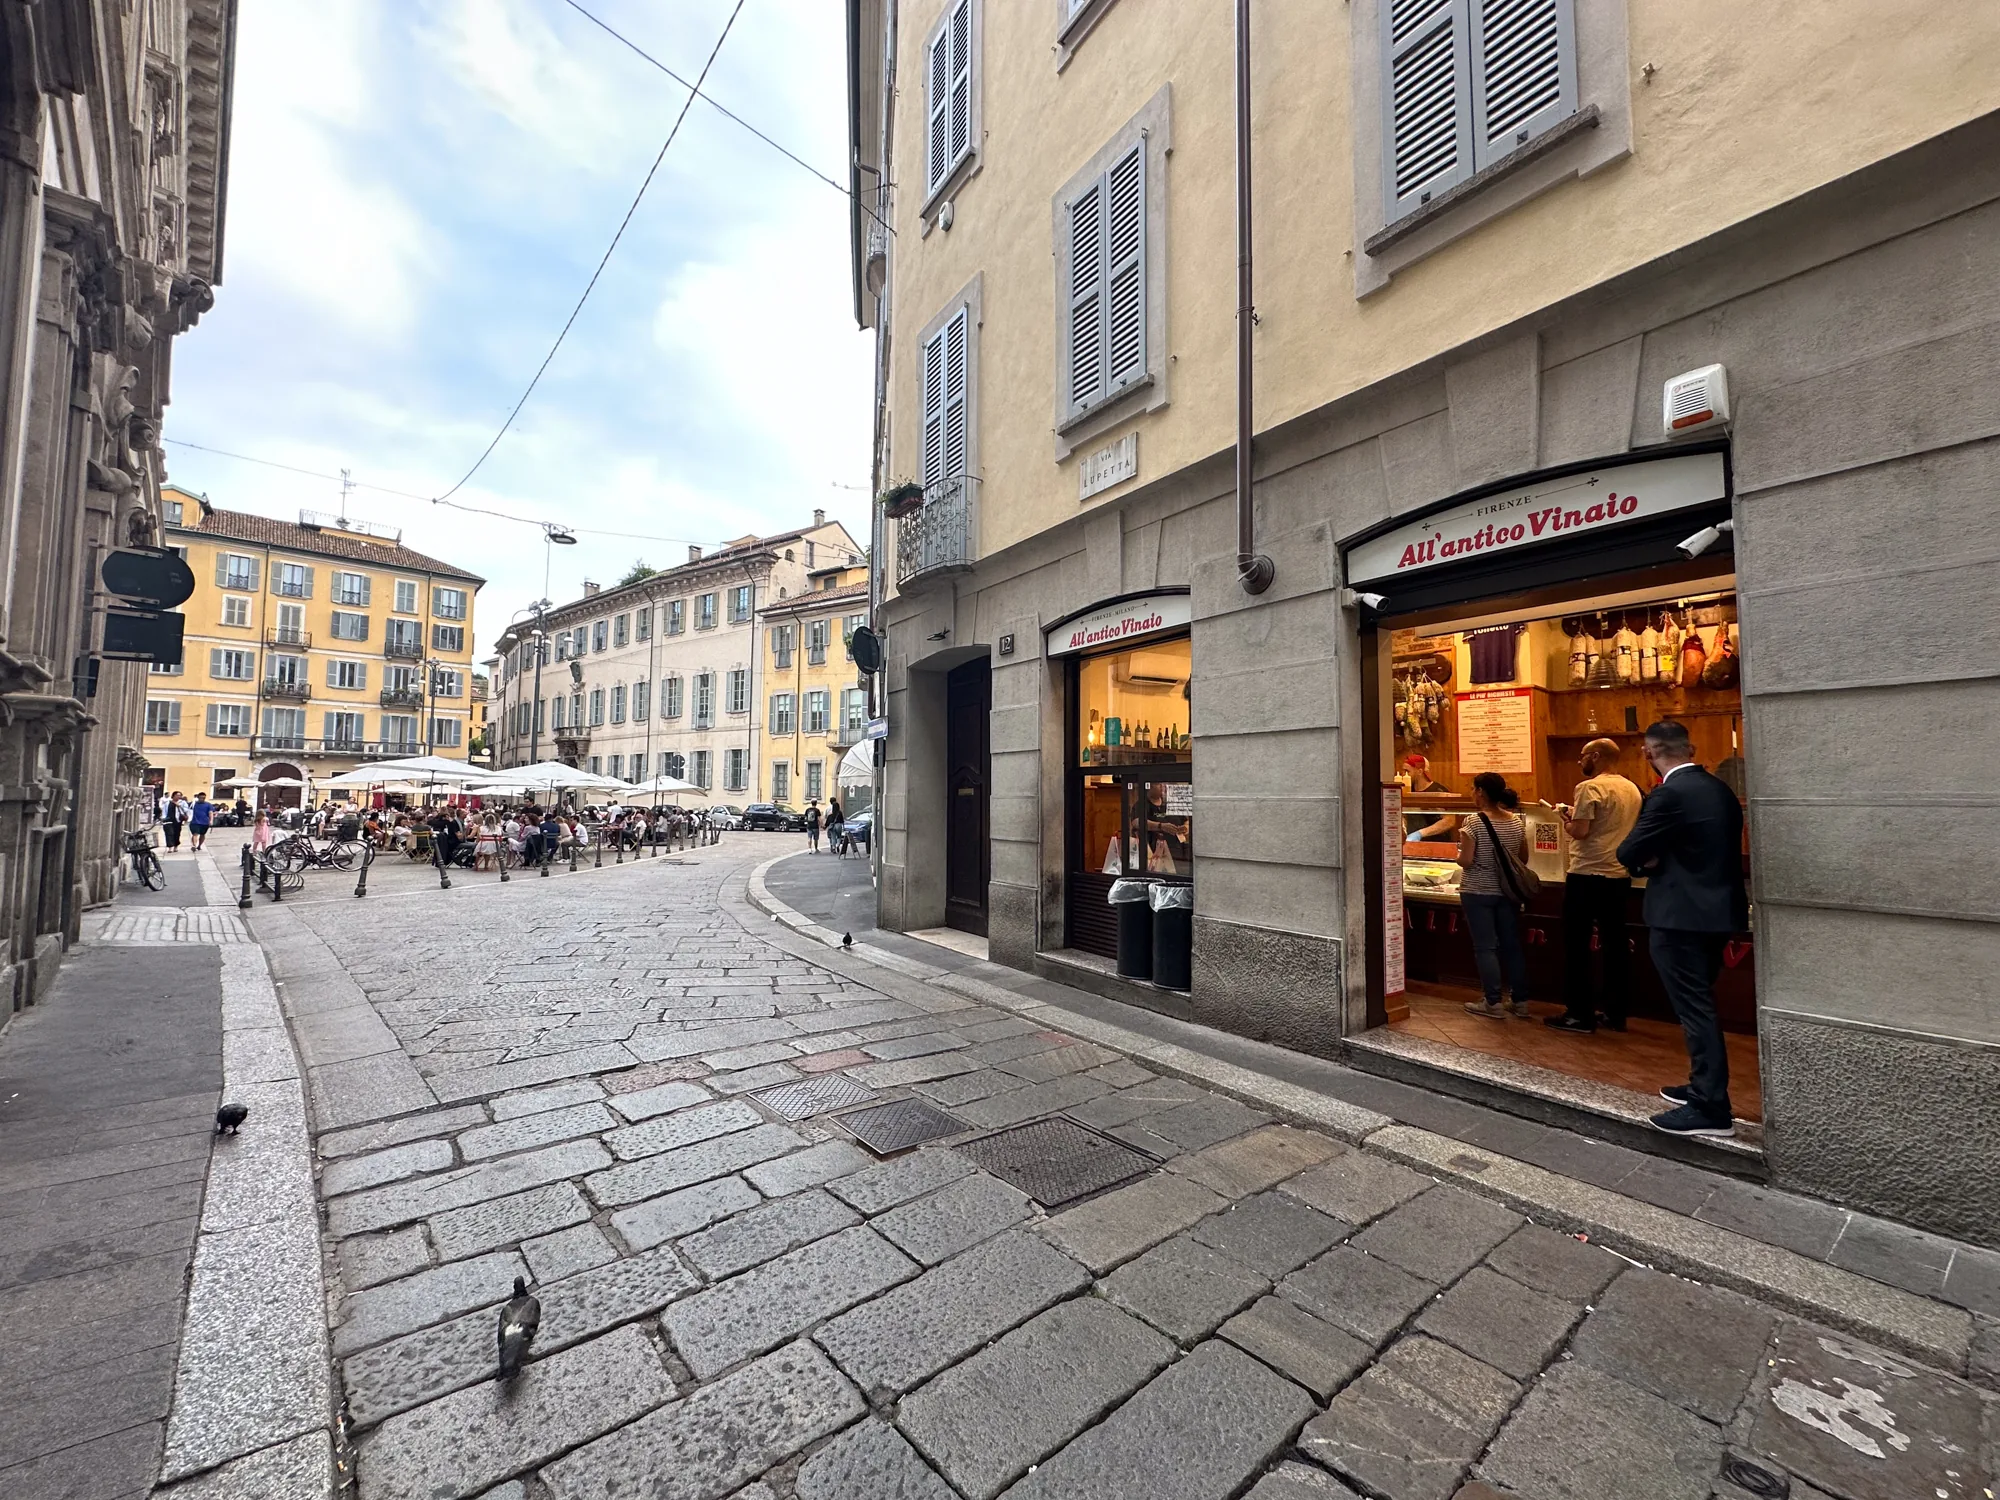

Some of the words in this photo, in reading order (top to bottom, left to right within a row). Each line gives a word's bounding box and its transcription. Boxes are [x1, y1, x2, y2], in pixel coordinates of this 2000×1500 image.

[1101, 452, 1112, 462] VIA
[1084, 459, 1131, 488] LUPETTA
[1477, 495, 1532, 517] FIRENZE
[1397, 524, 1525, 568] All'antico
[1527, 492, 1638, 536] Vinaio
[1091, 612, 1112, 622] FIRENZE
[1115, 605, 1135, 616] MILANO
[1069, 624, 1120, 648] All'antico
[1121, 612, 1163, 635] Vinaio
[1001, 636, 1011, 652] 12
[1535, 842, 1558, 850] MENU
